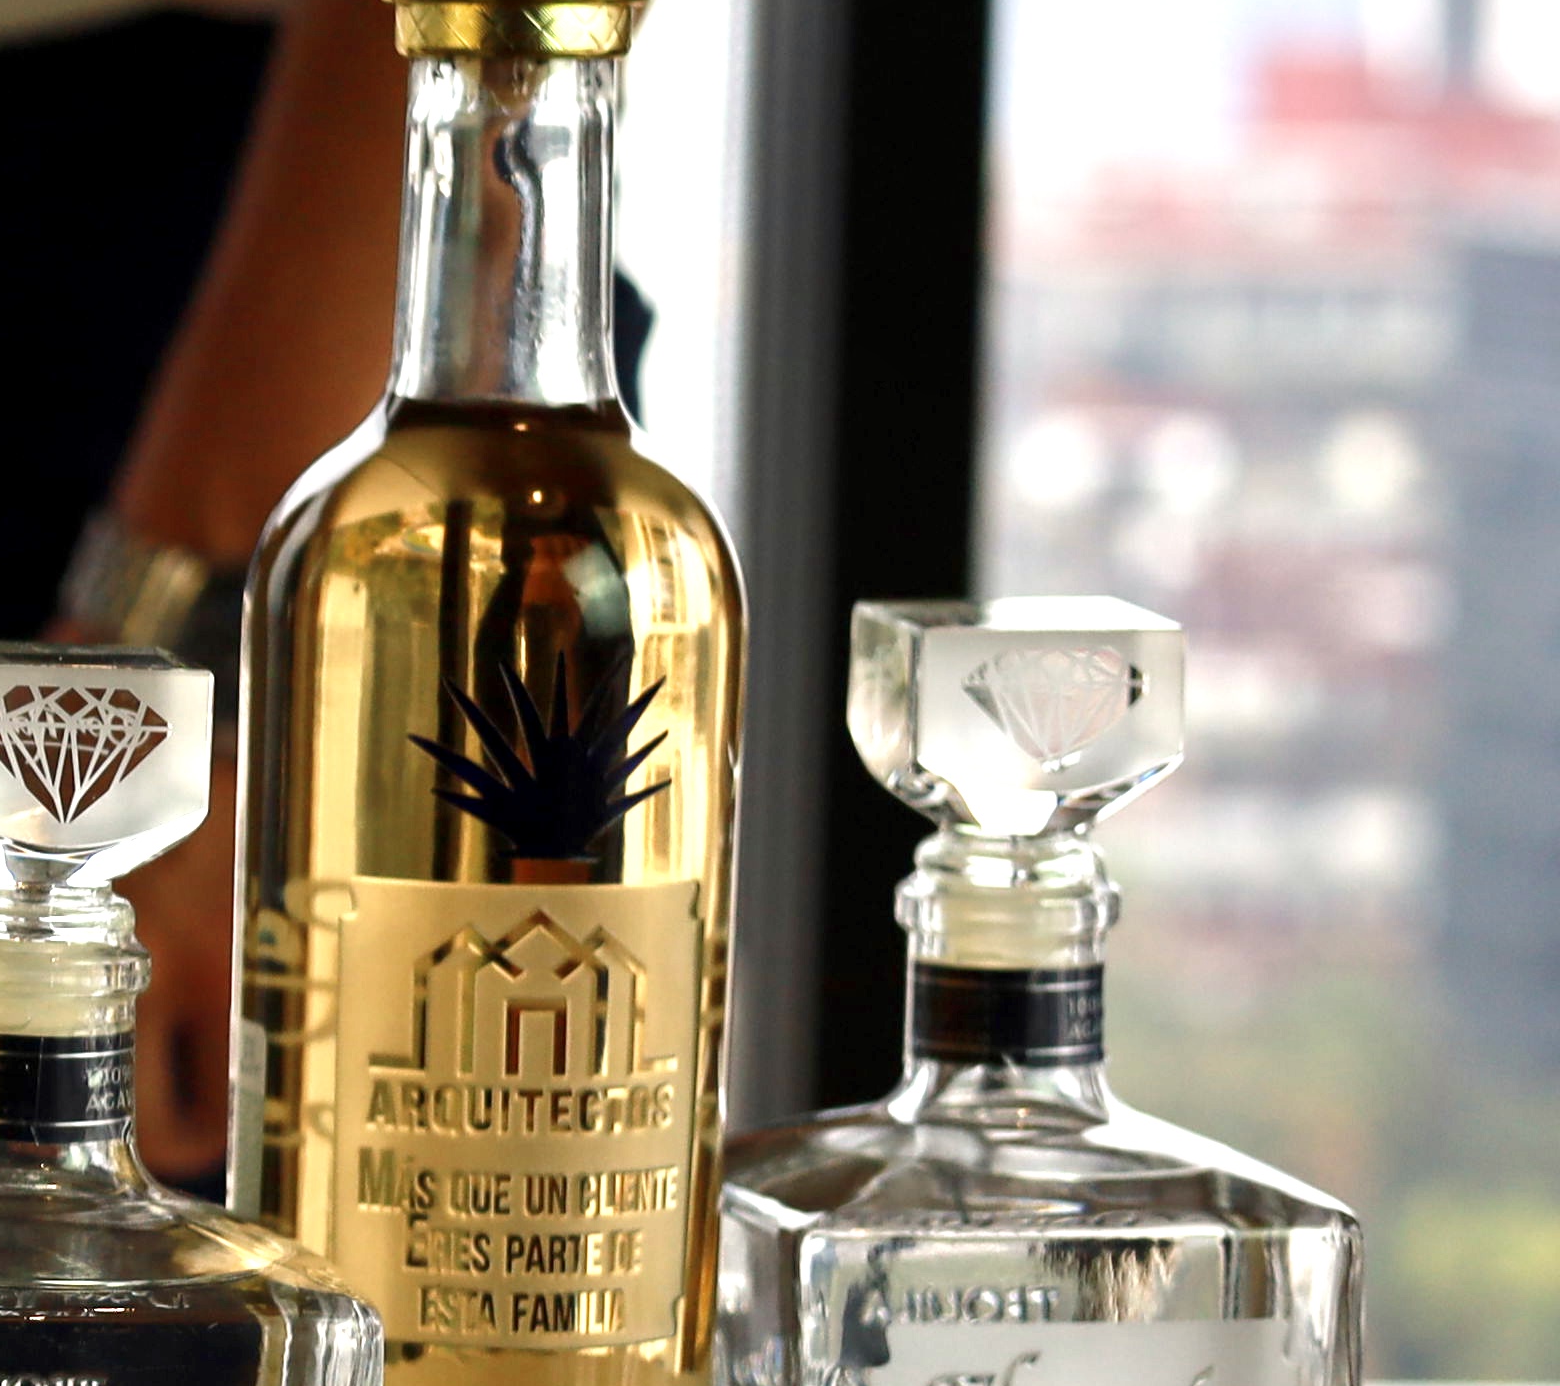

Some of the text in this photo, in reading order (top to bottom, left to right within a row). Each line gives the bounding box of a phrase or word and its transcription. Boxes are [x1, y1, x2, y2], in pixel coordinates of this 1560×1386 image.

[364, 1078, 677, 1135] ARQUITECTOS
[449, 1166, 512, 1221] QUE
[521, 1167, 570, 1221] UN
[576, 1160, 681, 1217] CLIENTE
[404, 1211, 492, 1275] ERES
[504, 1227, 605, 1277] PARTE
[418, 1288, 625, 1337] ESTA FAMILIA
